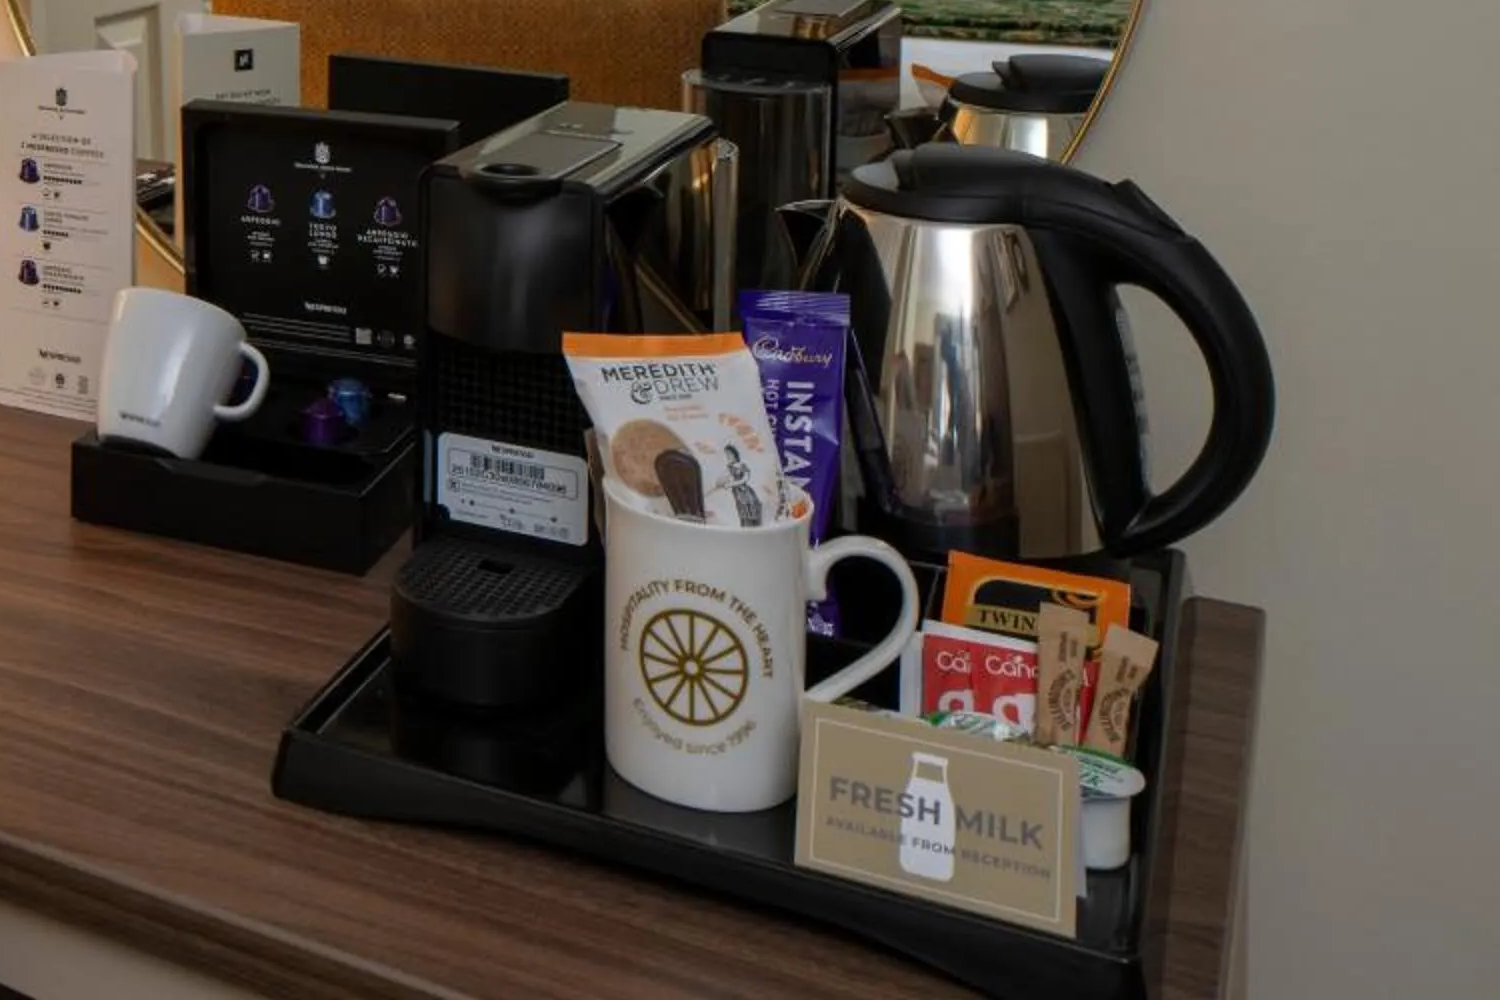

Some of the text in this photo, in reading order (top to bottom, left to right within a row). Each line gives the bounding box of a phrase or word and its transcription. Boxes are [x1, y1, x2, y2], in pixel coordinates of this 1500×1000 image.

[752, 332, 833, 368] Cadbury
[601, 363, 715, 383] MEREDITH
[653, 376, 719, 395] DREW
[765, 379, 781, 410] HOT
[674, 579, 726, 603] FROM
[729, 595, 758, 625] THE
[752, 621, 773, 679] HEART
[829, 775, 1044, 849] FRESH MILK
[826, 816, 1051, 879] AVAILABLE FROM RECEPTION
